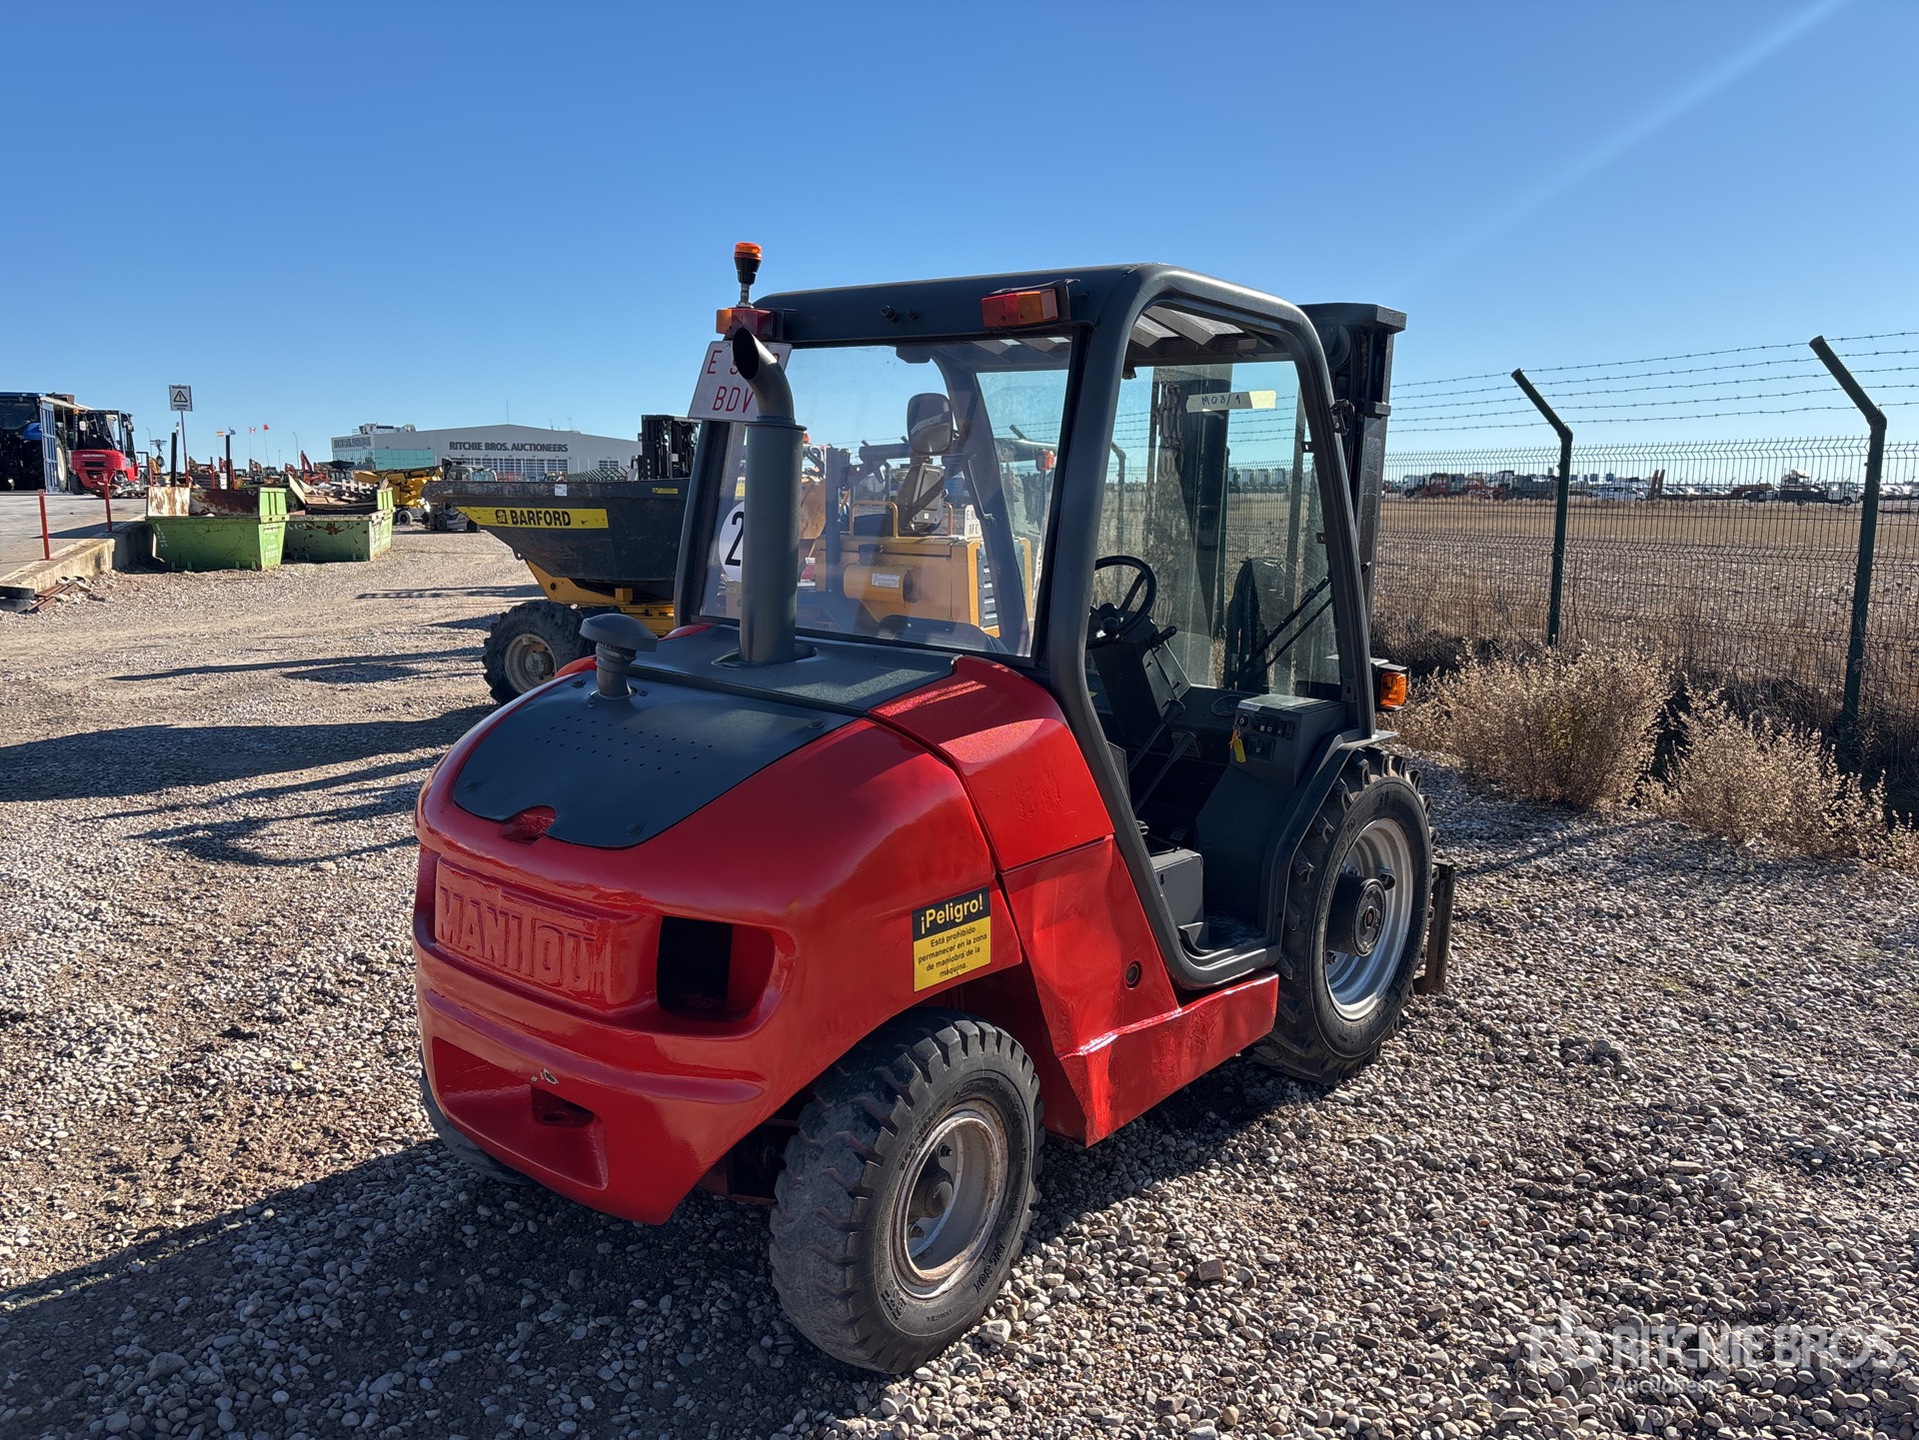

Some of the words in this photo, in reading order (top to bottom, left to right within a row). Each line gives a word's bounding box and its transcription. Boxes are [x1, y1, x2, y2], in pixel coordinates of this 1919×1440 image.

[707, 349, 722, 375] E
[712, 385, 754, 413] BDV
[449, 441, 483, 451] RITCHIE
[484, 442, 510, 452] BROS.
[511, 442, 569, 452] AUCTIONEERS
[510, 509, 572, 527] BARFORD
[921, 892, 983, 935] ¡Peligro!
[918, 944, 956, 965] permanecer
[957, 941, 965, 949] en
[972, 932, 987, 944] zona
[930, 936, 946, 948] Está
[945, 926, 976, 944] prohibido
[926, 962, 934, 972] de
[935, 951, 965, 969] maniobra
[965, 948, 974, 957] de
